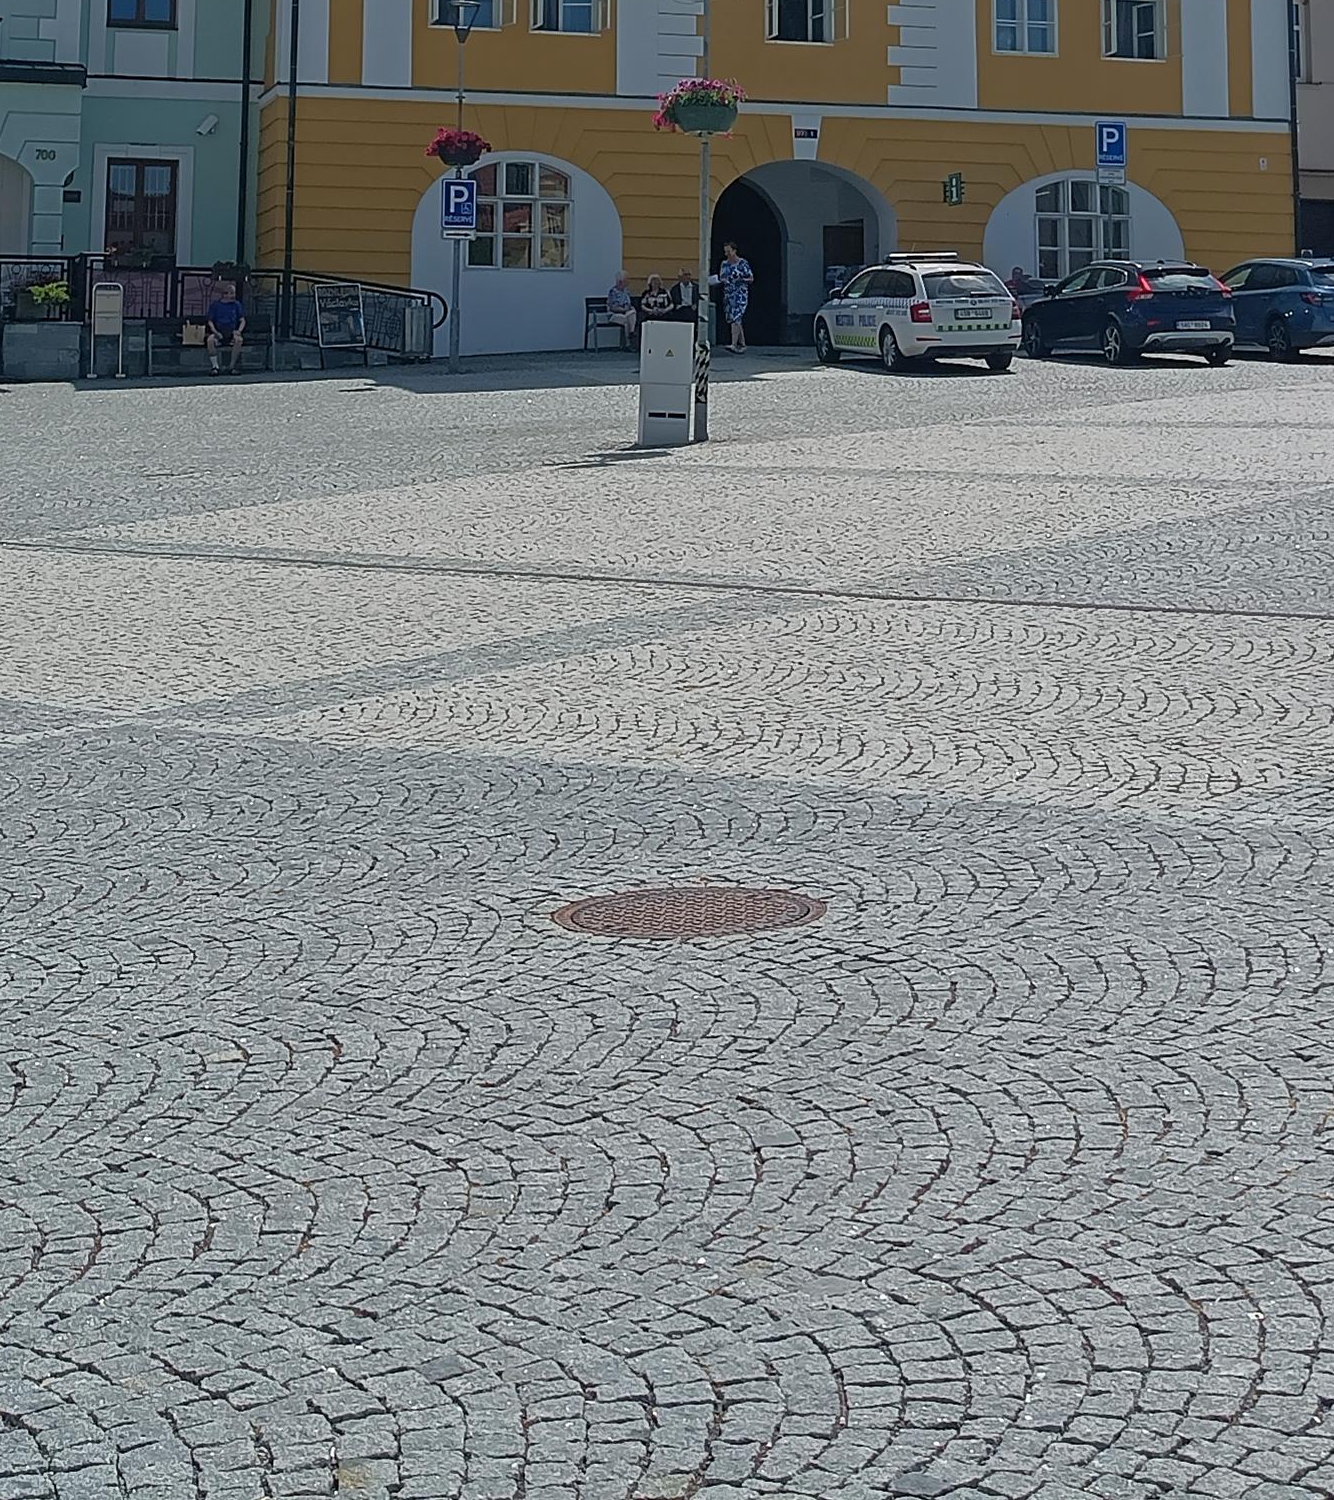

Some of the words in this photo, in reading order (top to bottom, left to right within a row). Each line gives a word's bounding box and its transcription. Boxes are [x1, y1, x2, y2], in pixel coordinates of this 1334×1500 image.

[1102, 127, 1119, 152] P
[35, 148, 56, 161] 700
[450, 185, 469, 213] P
